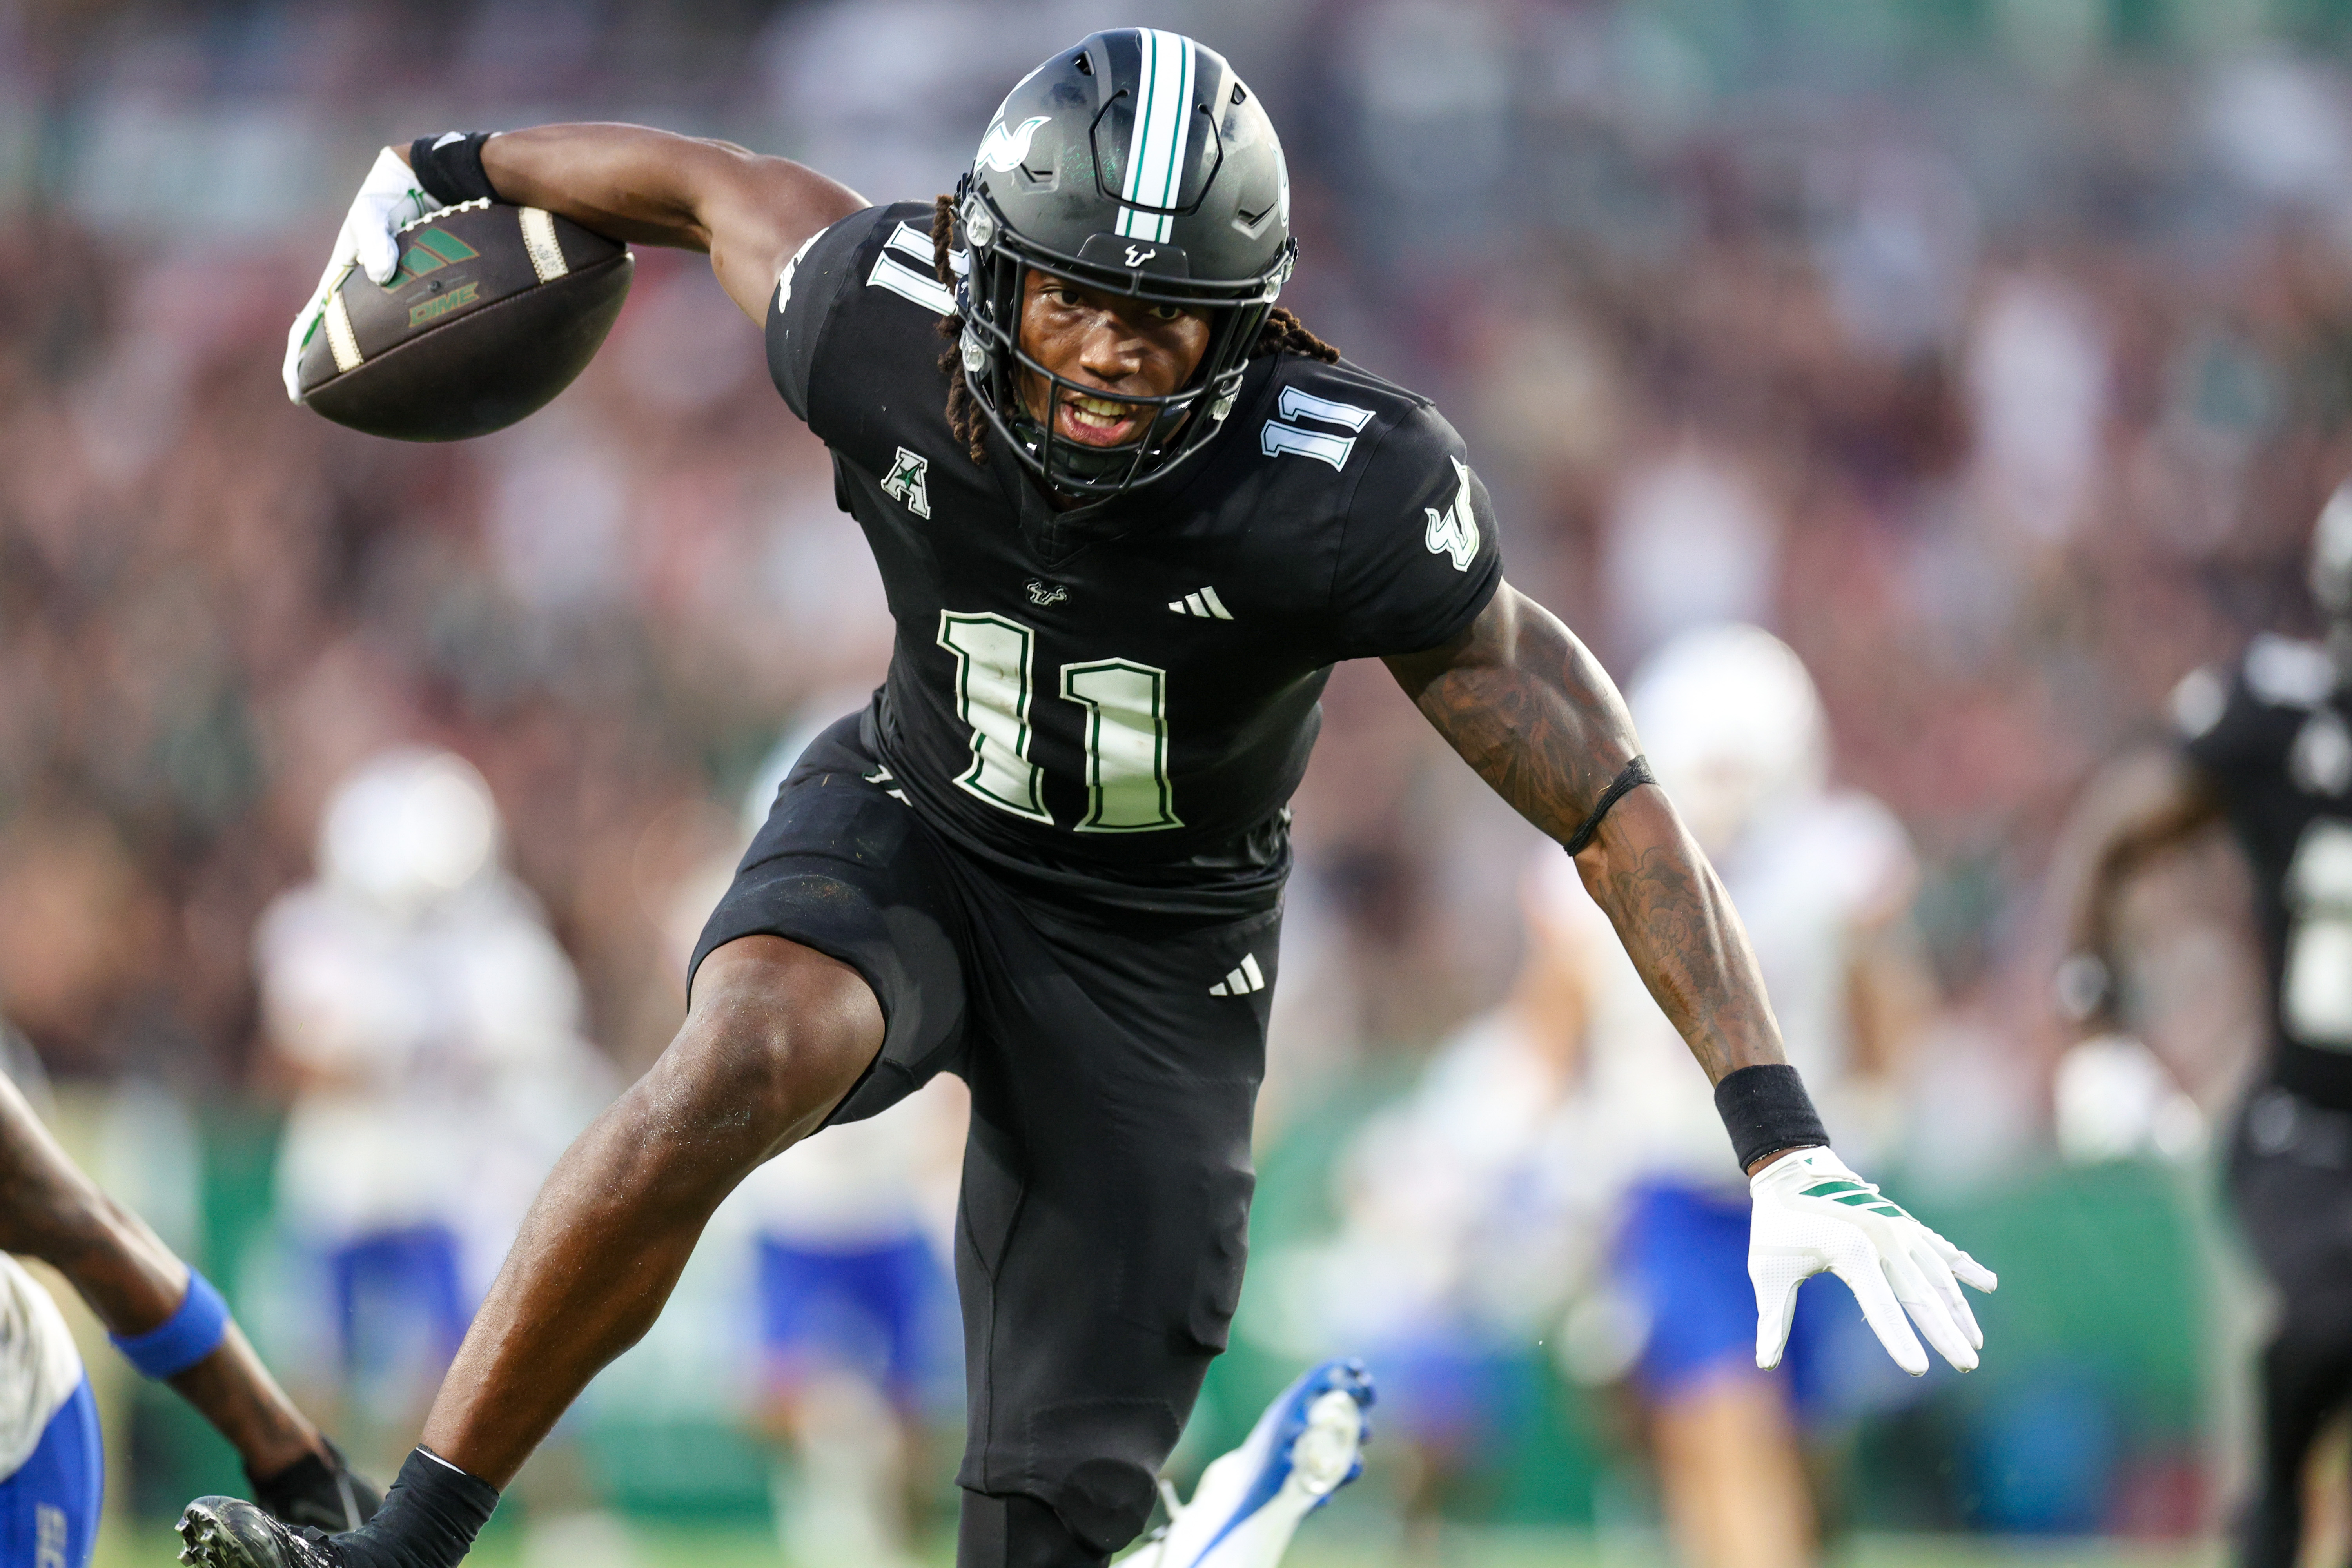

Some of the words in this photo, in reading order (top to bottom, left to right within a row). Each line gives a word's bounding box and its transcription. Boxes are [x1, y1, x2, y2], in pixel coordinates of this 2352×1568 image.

[408, 281, 480, 328] DIME
[1260, 385, 1376, 472] 11
[881, 446, 931, 520] A
[936, 609, 1185, 833] 11
[1880, 1303, 1914, 1351] ADIZERO
